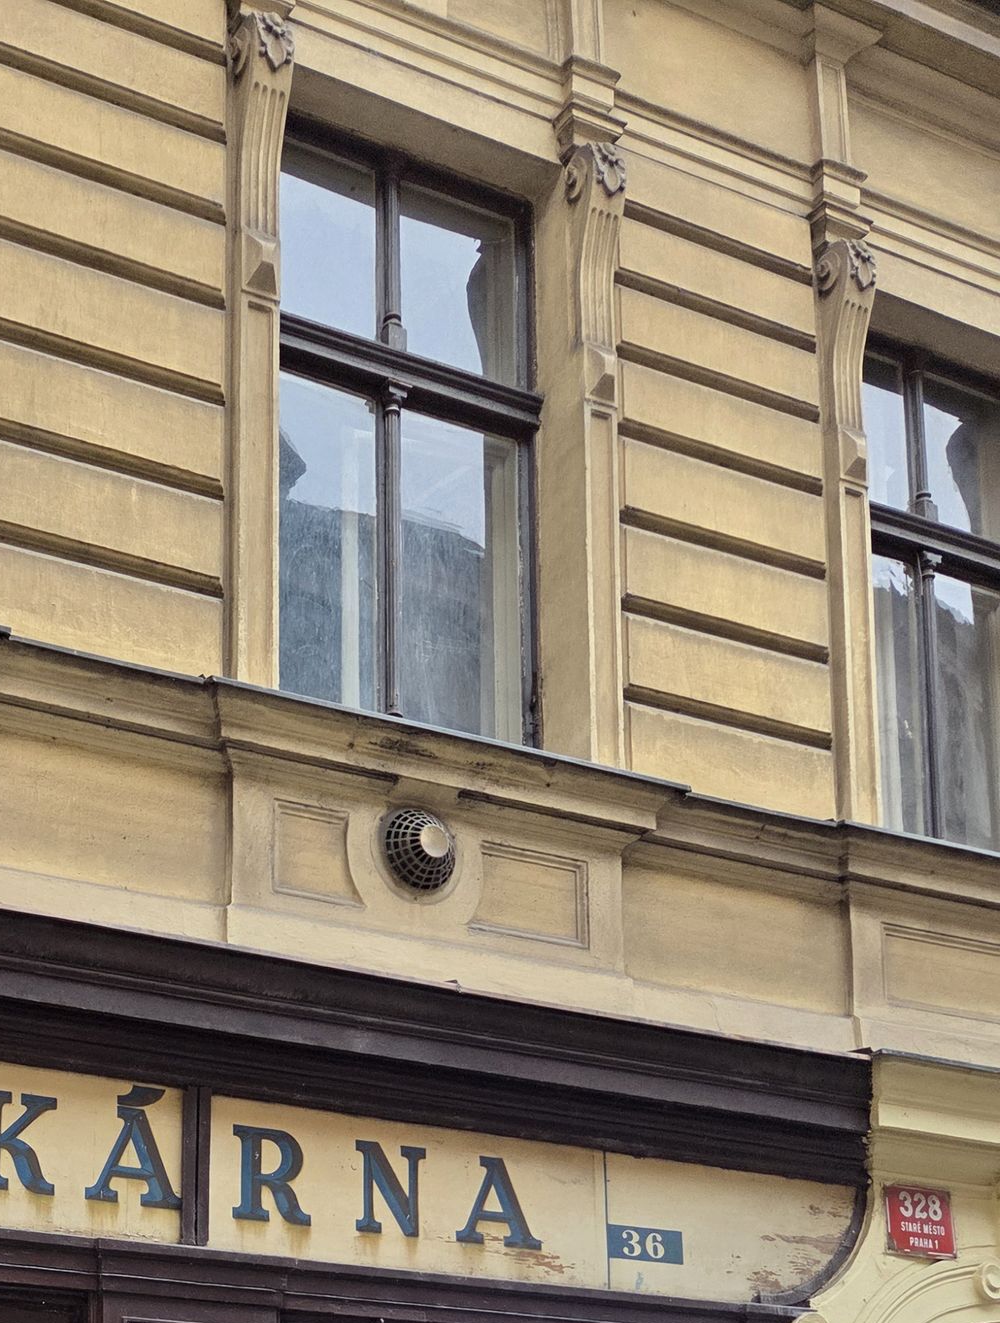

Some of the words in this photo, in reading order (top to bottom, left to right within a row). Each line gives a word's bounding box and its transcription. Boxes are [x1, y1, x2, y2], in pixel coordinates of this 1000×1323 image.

[898, 1190, 943, 1222] 328
[900, 1220, 921, 1234] STARÉ
[922, 1222, 945, 1237] MĚSTO
[621, 1229, 666, 1260] 36
[909, 1236, 933, 1249] PRAHA
[934, 1239, 939, 1250] 1
